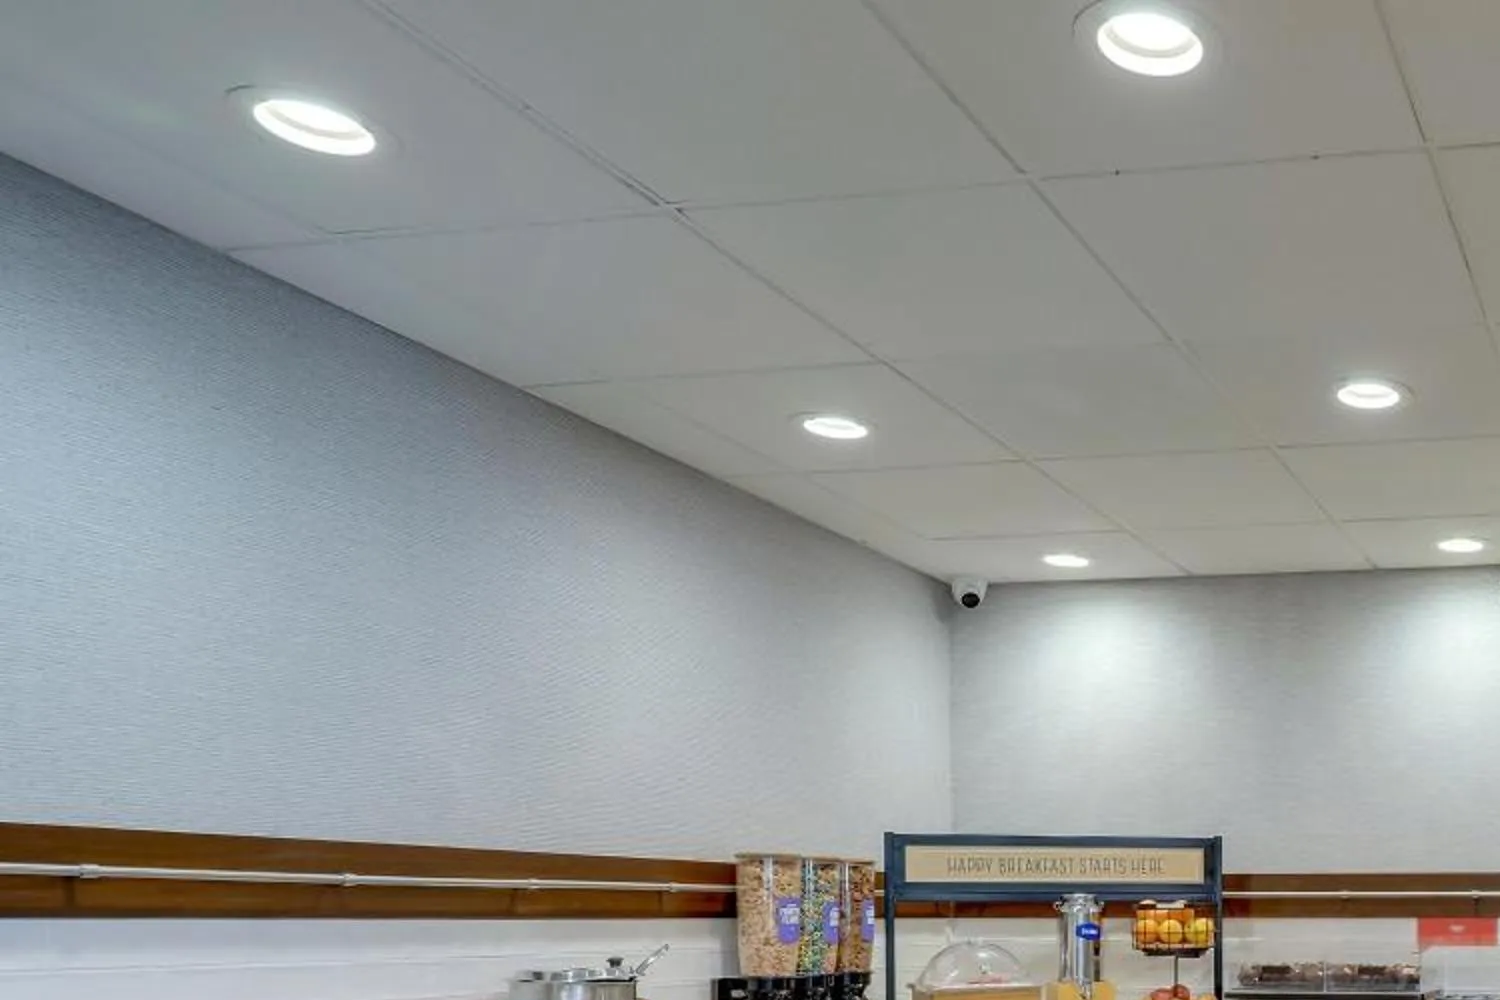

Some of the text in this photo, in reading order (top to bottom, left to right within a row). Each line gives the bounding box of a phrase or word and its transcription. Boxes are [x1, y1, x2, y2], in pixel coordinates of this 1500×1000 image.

[946, 854, 1166, 876] HAPPY BREAKFAST STARTS HERE
